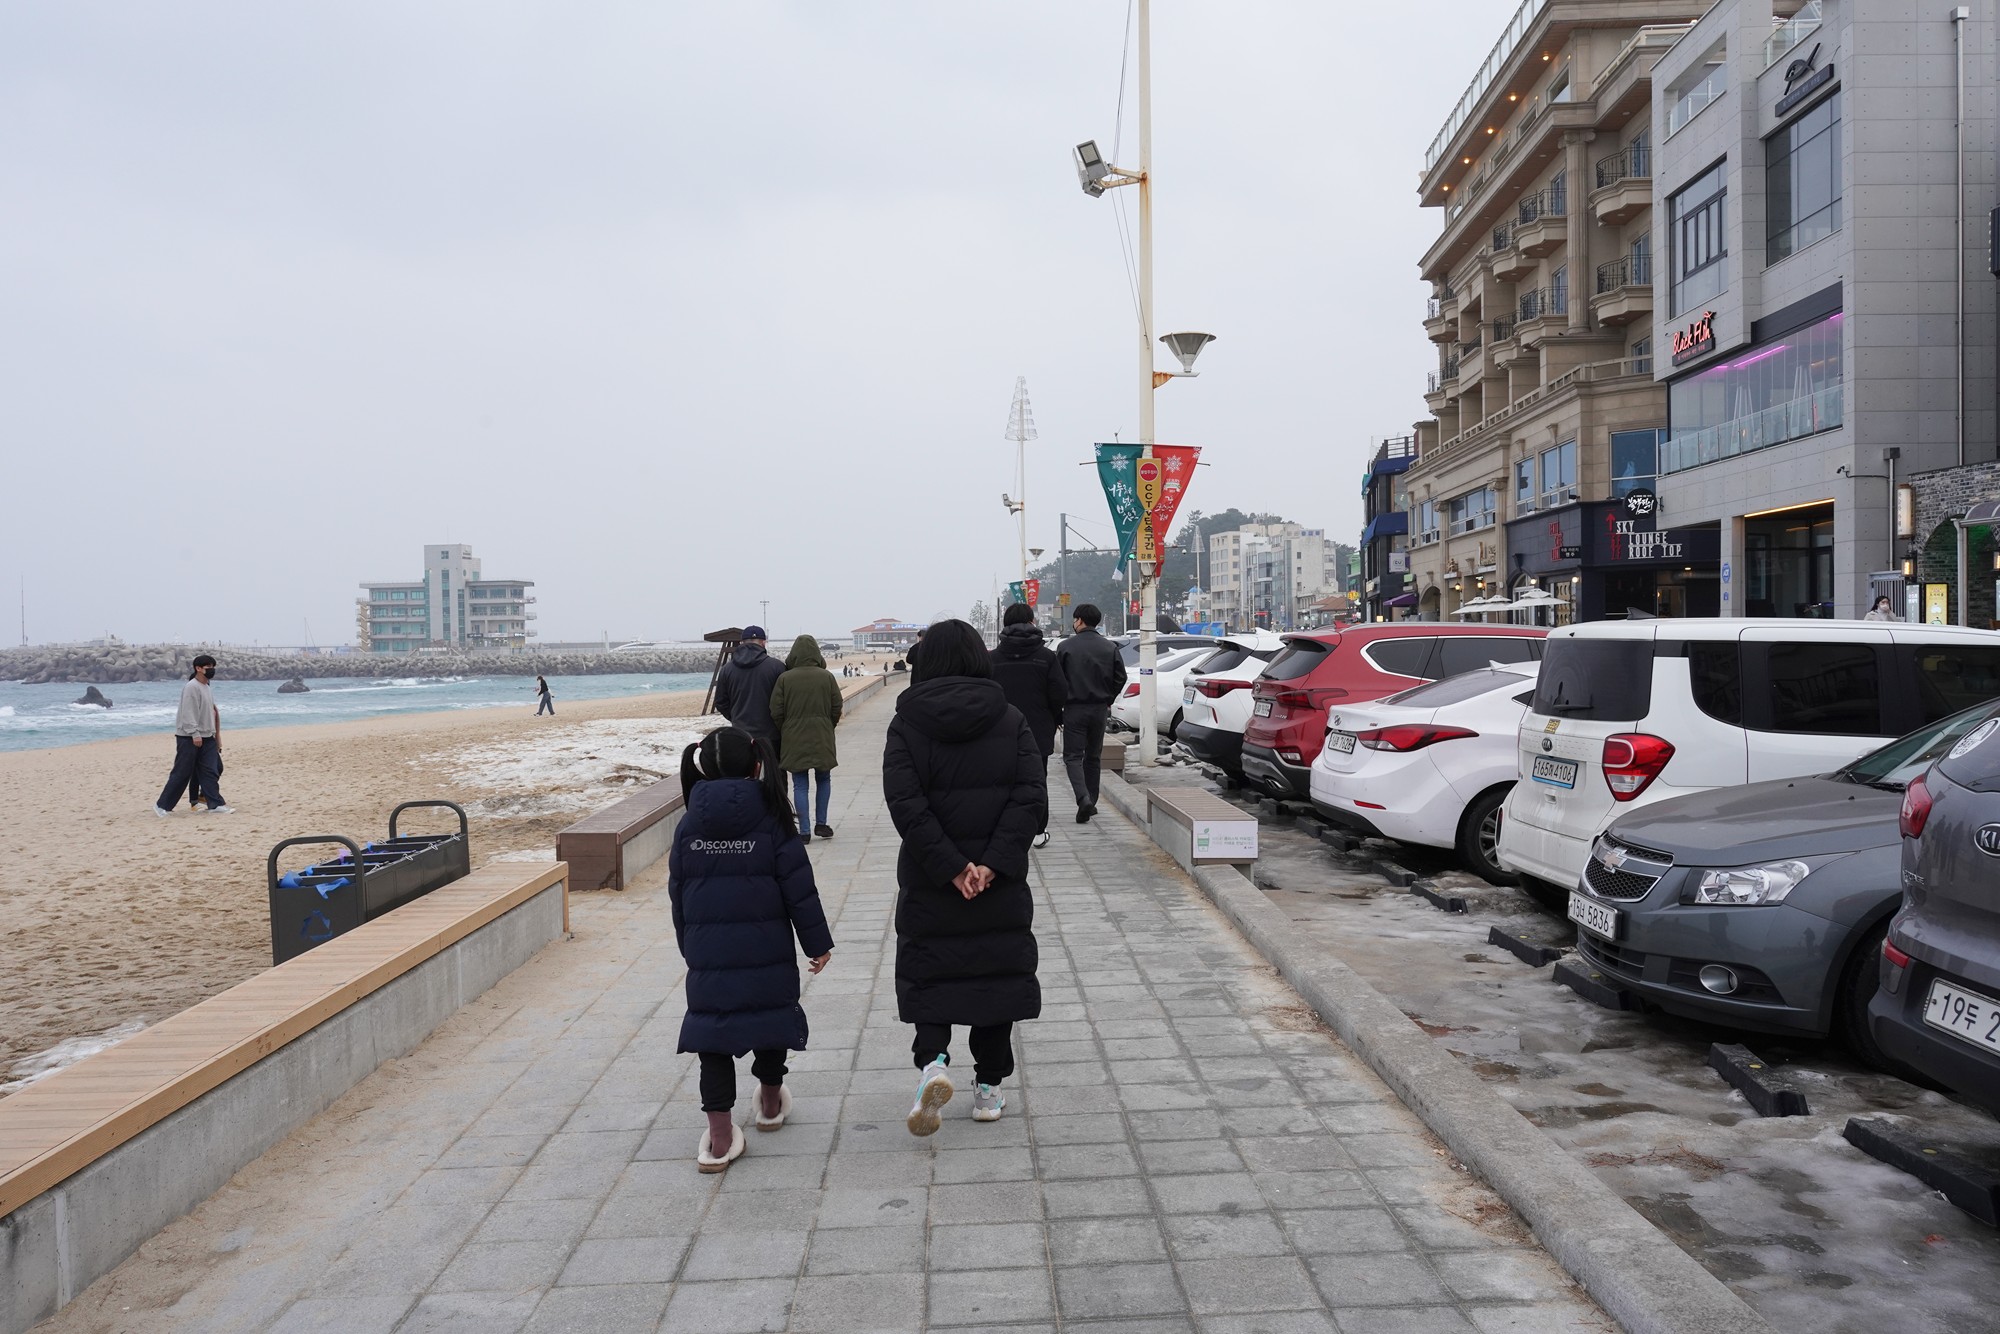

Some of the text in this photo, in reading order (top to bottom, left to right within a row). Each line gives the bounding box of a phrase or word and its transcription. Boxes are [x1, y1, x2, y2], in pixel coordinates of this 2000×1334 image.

[1673, 324, 1694, 355] Black
[1616, 521, 1634, 534] SKY
[1628, 533, 1668, 545] LOUNGE
[1628, 544, 1682, 559] ROOF TOP
[691, 839, 756, 853] Discovery
[1587, 905, 1609, 933] 5836
[1941, 992, 2000, 1043] 19두 2
